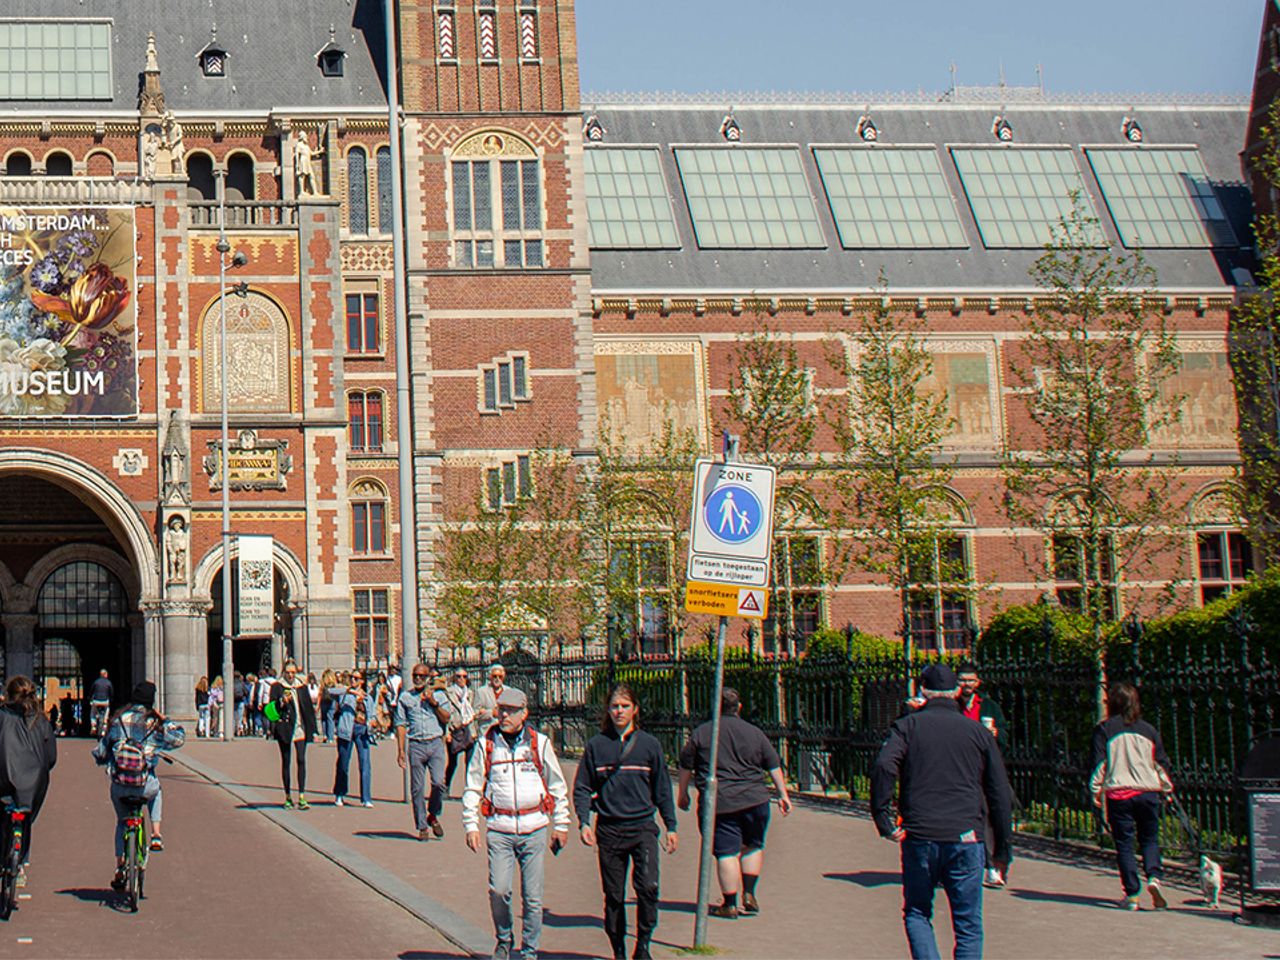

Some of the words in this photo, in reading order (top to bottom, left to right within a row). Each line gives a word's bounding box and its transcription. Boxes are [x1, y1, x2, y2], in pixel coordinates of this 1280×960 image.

[718, 469, 753, 482] ZONE
[694, 559, 721, 568] fietsen
[722, 562, 764, 572] toegestaan
[689, 588, 739, 599] snorfietsers
[688, 599, 726, 608] verboden
